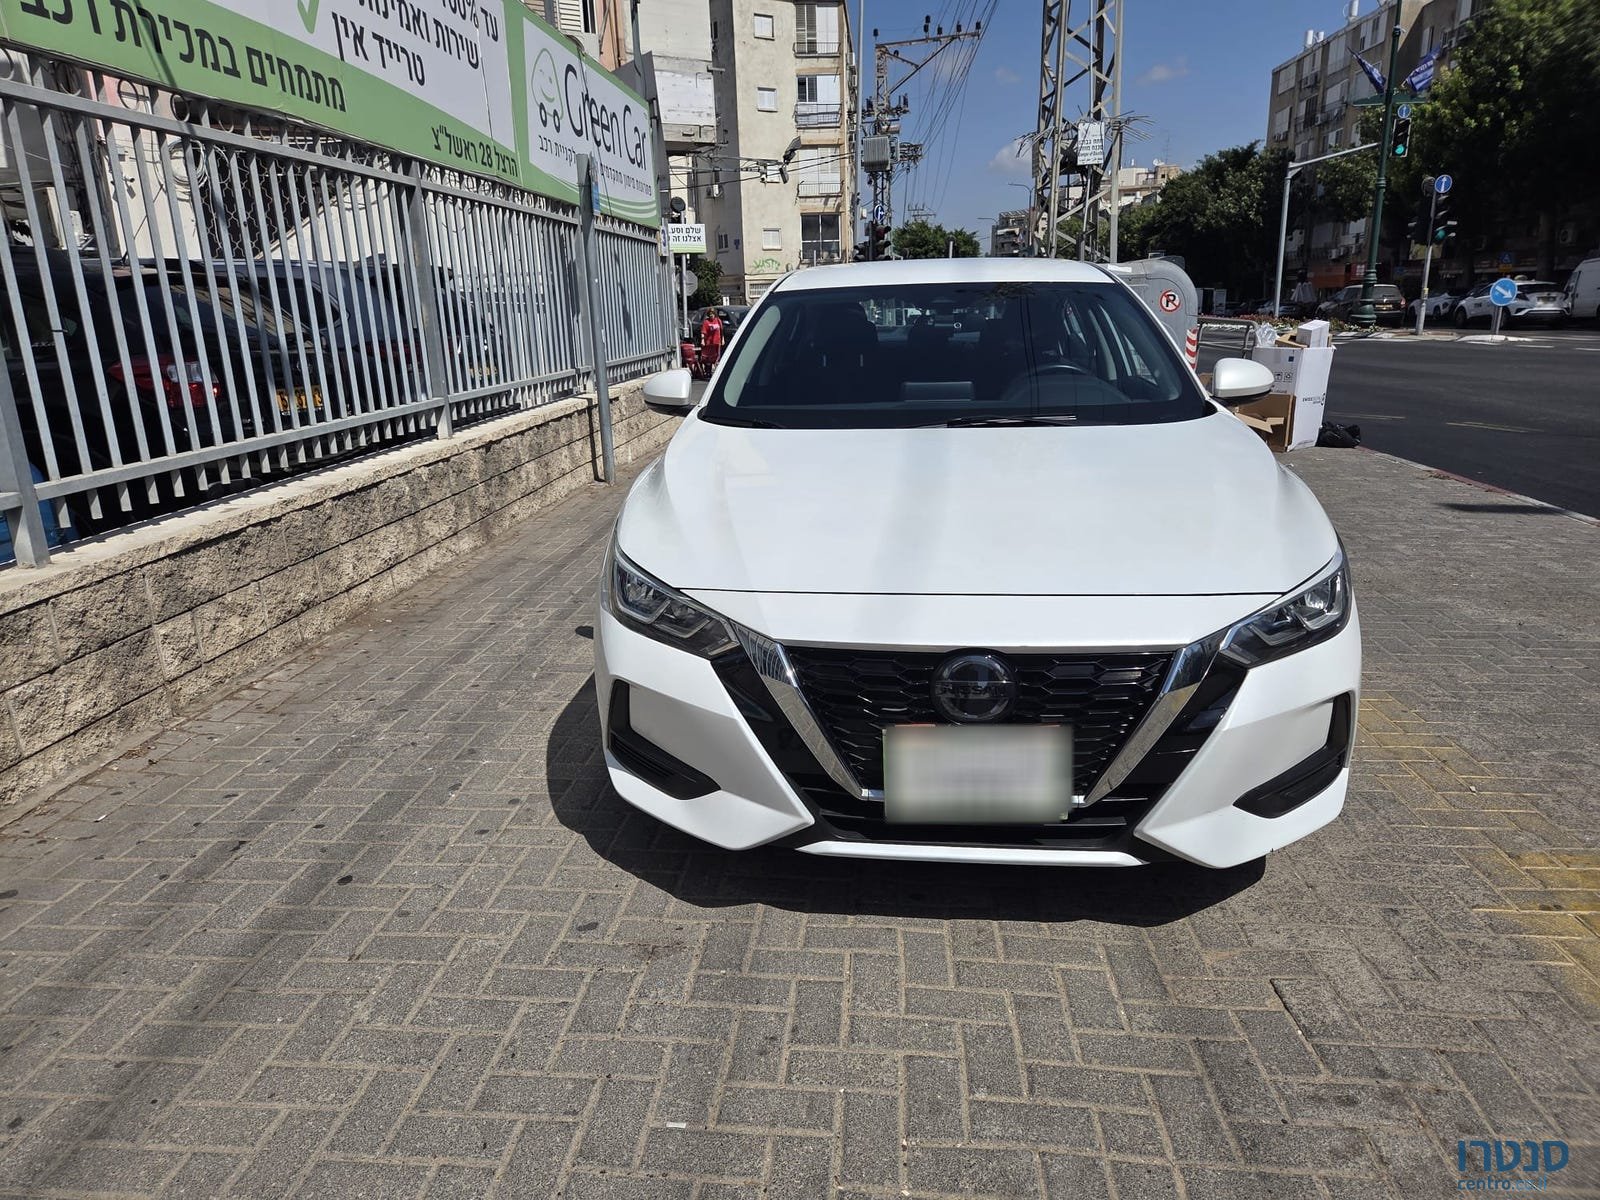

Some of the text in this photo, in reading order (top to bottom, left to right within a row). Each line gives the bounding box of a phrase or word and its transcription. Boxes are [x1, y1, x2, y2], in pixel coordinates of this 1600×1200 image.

[110, 0, 241, 79] במכירת
[480, 7, 499, 42] עד
[332, 11, 425, 86] טרייד אין
[433, 18, 479, 70] שירות
[246, 46, 346, 113] מתמחים
[564, 63, 647, 171] Green Car
[480, 142, 493, 168] 28
[494, 145, 519, 177] הרצל
[538, 135, 553, 154] רכב
[682, 234, 702, 242] אצלנו
[685, 226, 701, 234] שלם
